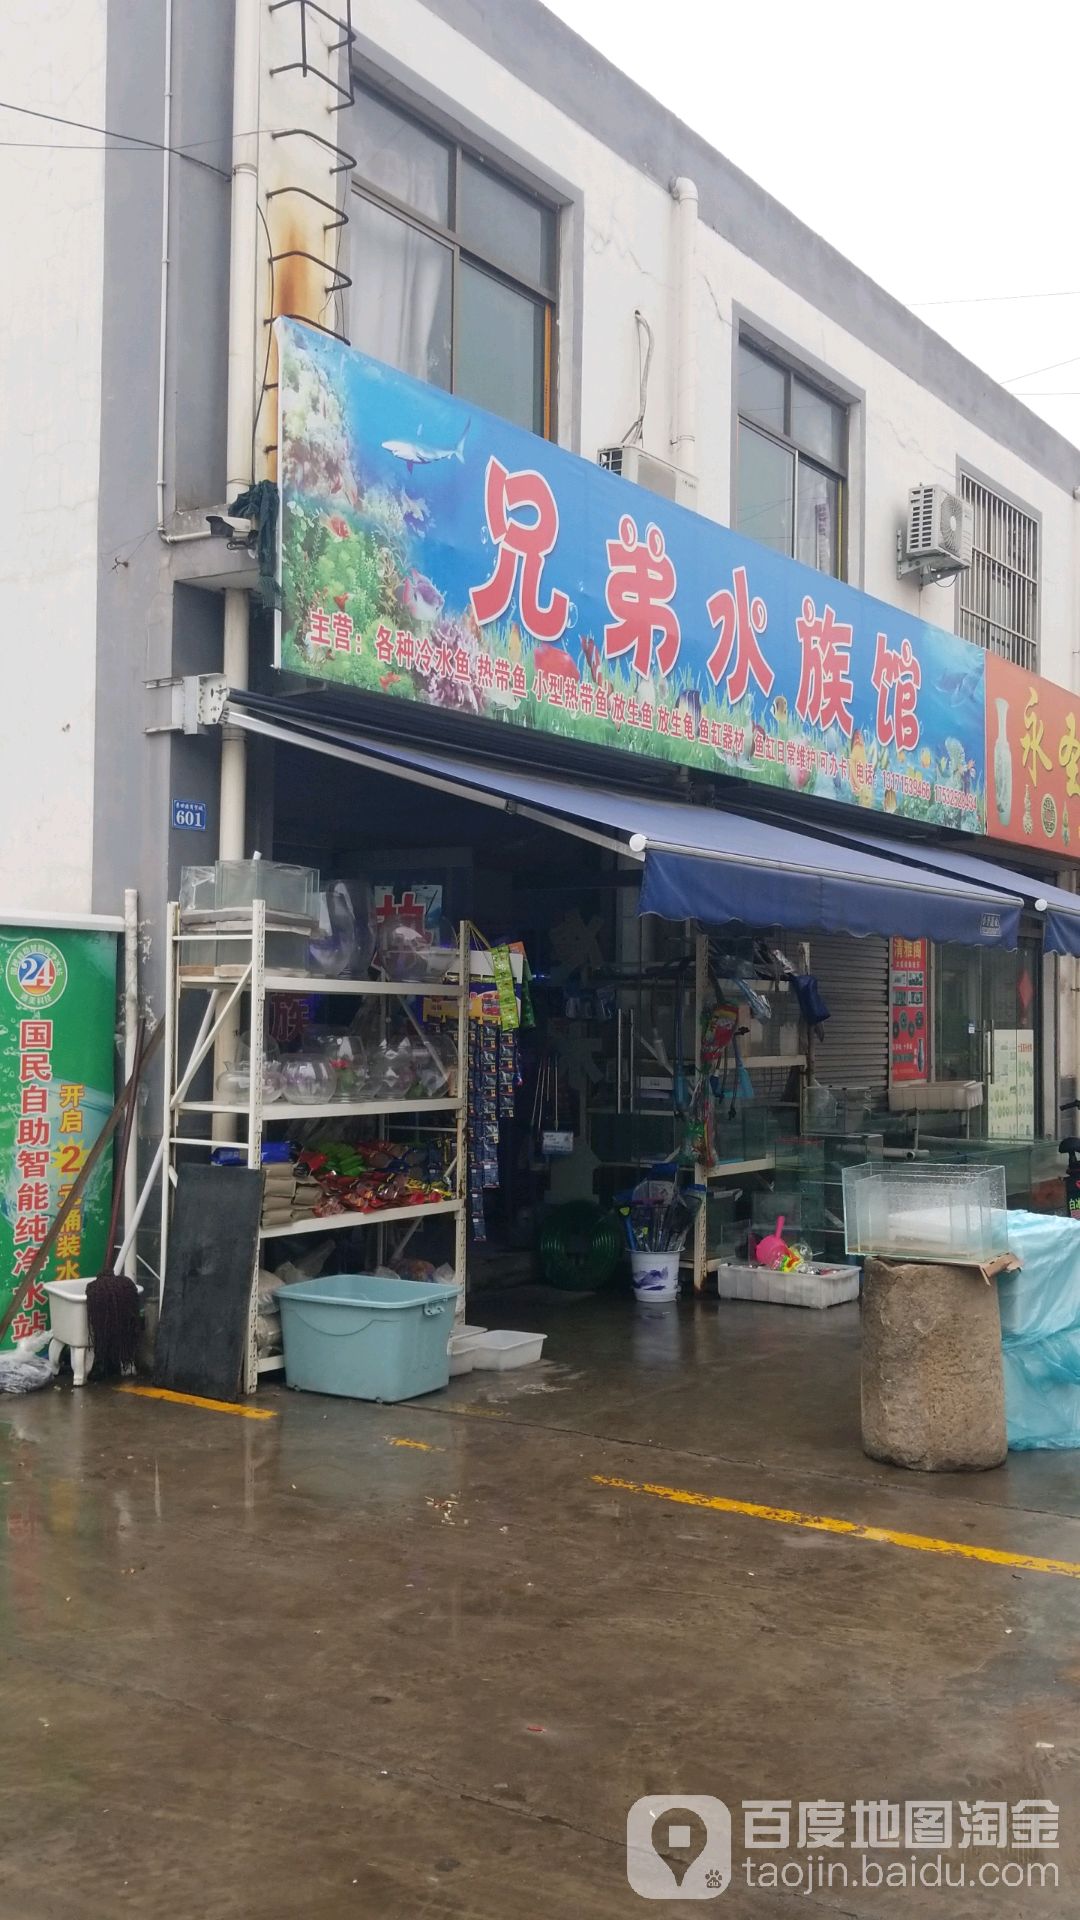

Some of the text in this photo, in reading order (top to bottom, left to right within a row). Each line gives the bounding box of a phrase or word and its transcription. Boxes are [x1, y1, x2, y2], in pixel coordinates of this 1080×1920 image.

[467, 455, 922, 751] 兄弟水族馆
[375, 624, 471, 682] 各种冷水鱼
[477, 654, 527, 698] 热带鱼
[532, 669, 608, 718] 小型热带鱼
[612, 694, 653, 730] 放生鱼
[698, 717, 745, 753] 鱼缸器材
[176, 810, 202, 827] 601
[19, 957, 54, 987] 24
